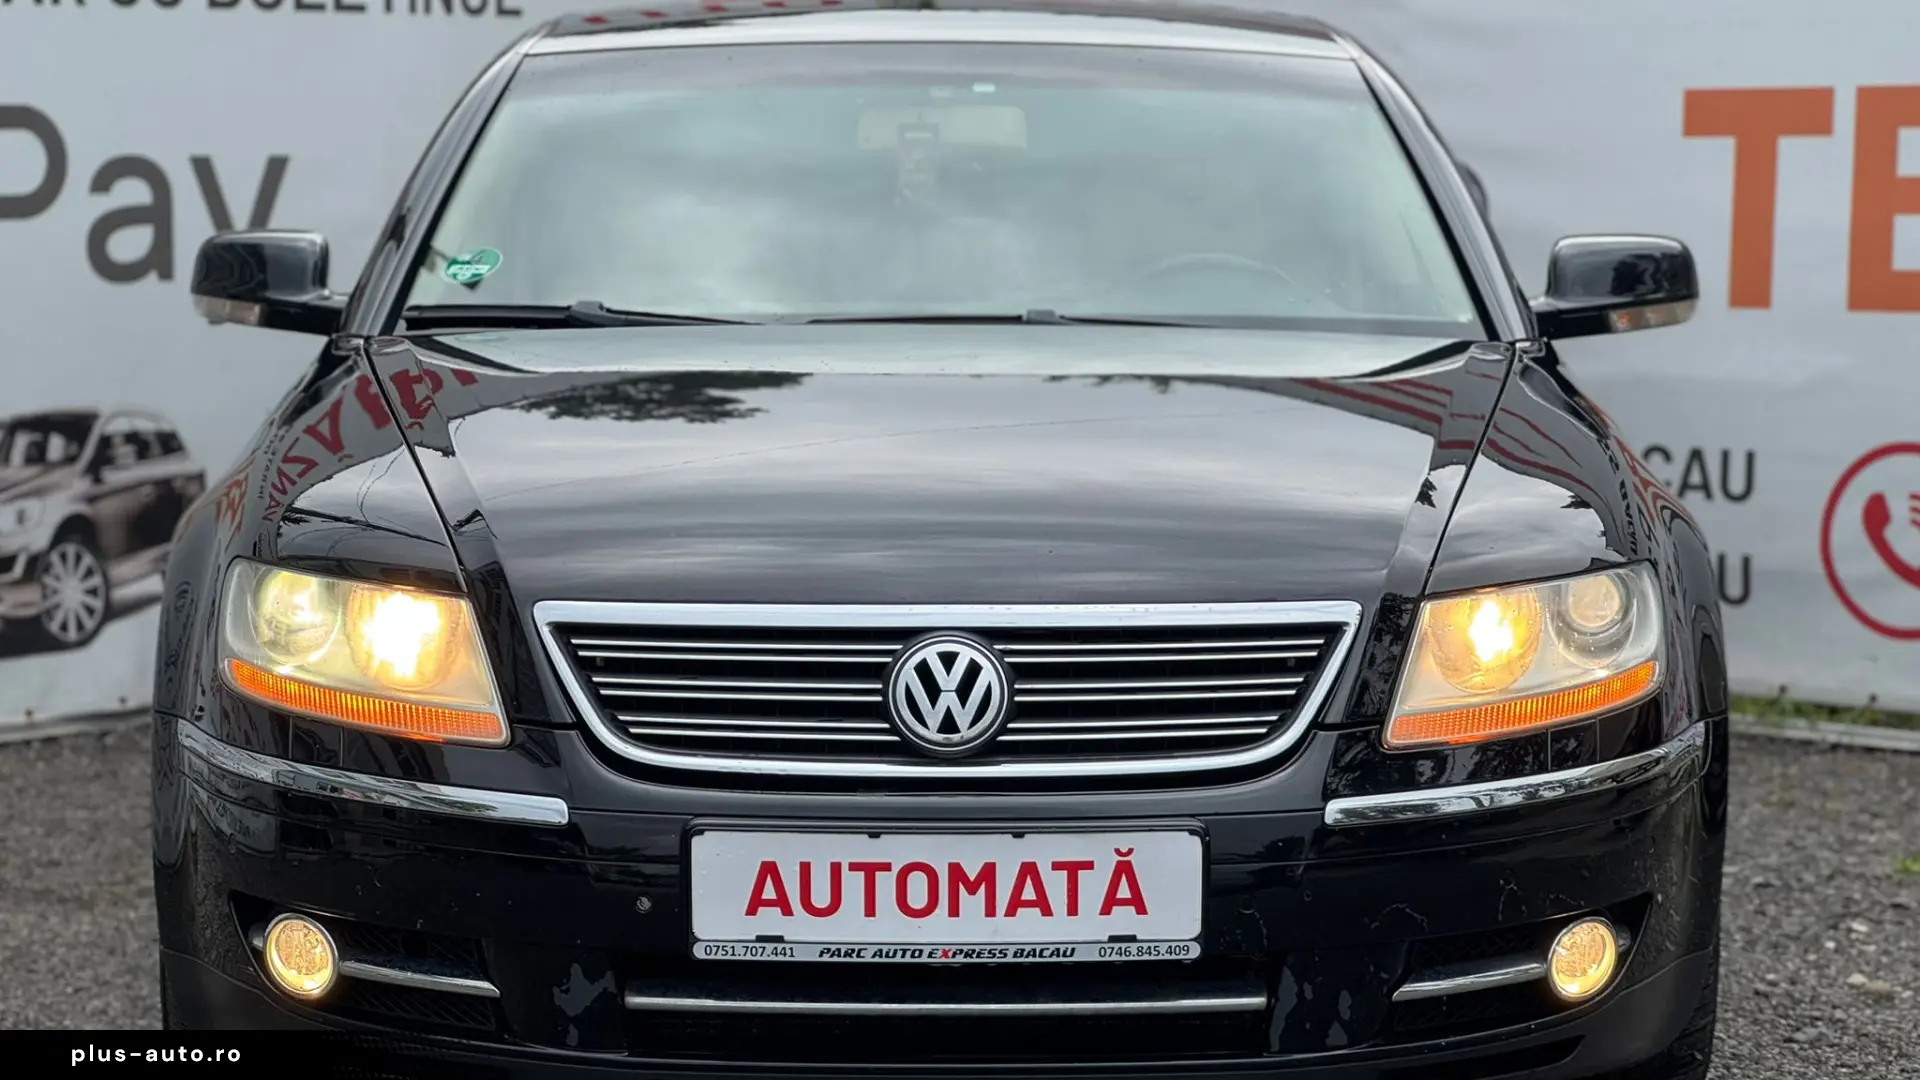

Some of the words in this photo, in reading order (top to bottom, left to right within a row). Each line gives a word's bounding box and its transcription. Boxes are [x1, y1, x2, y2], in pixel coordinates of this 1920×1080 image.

[896, 643, 1000, 744] VW
[744, 846, 1149, 918] AUTOMATĂ
[704, 945, 796, 959] 0751.707.441
[818, 947, 869, 959] PARC
[870, 948, 923, 959] AUTO
[926, 948, 1009, 959] EXPRESS
[1012, 947, 1076, 959] BACAU
[1098, 944, 1191, 958] 0746.845.409
